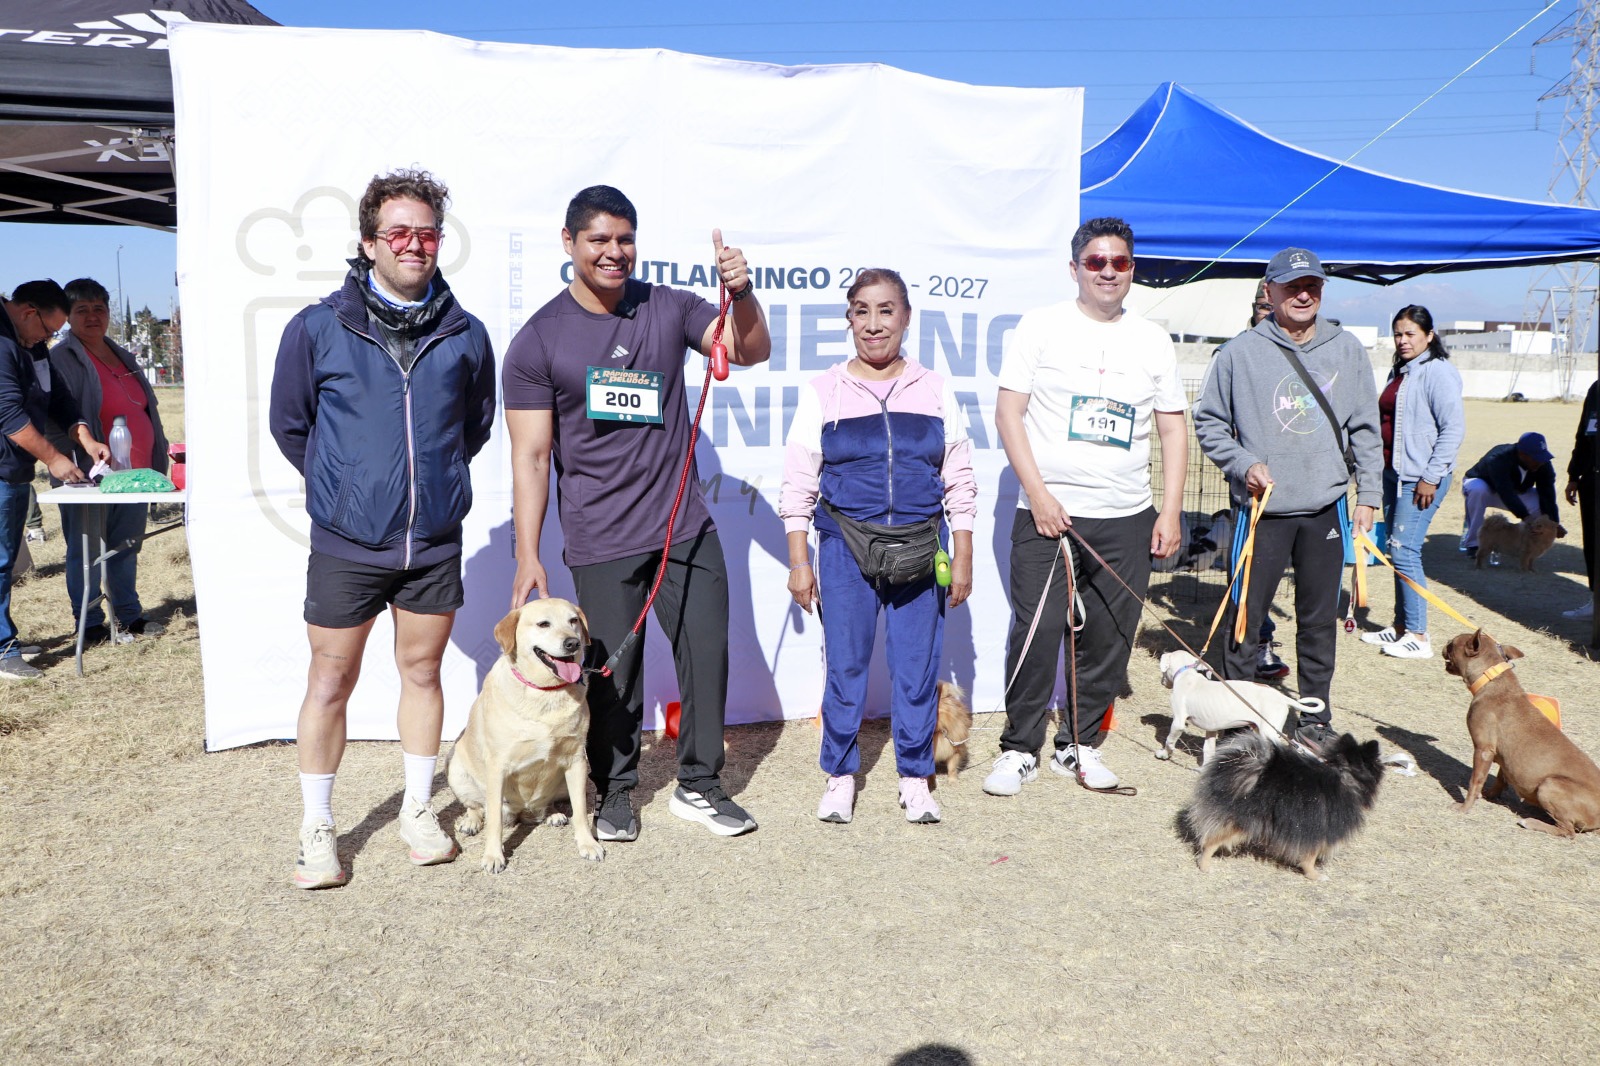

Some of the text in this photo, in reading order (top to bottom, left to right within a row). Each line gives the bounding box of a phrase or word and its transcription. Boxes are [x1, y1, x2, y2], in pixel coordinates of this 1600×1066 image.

[928, 275, 989, 299] 2027
[609, 376, 650, 385] PELUDOS
[606, 392, 641, 408] 200
[1088, 417, 1116, 432] 191
